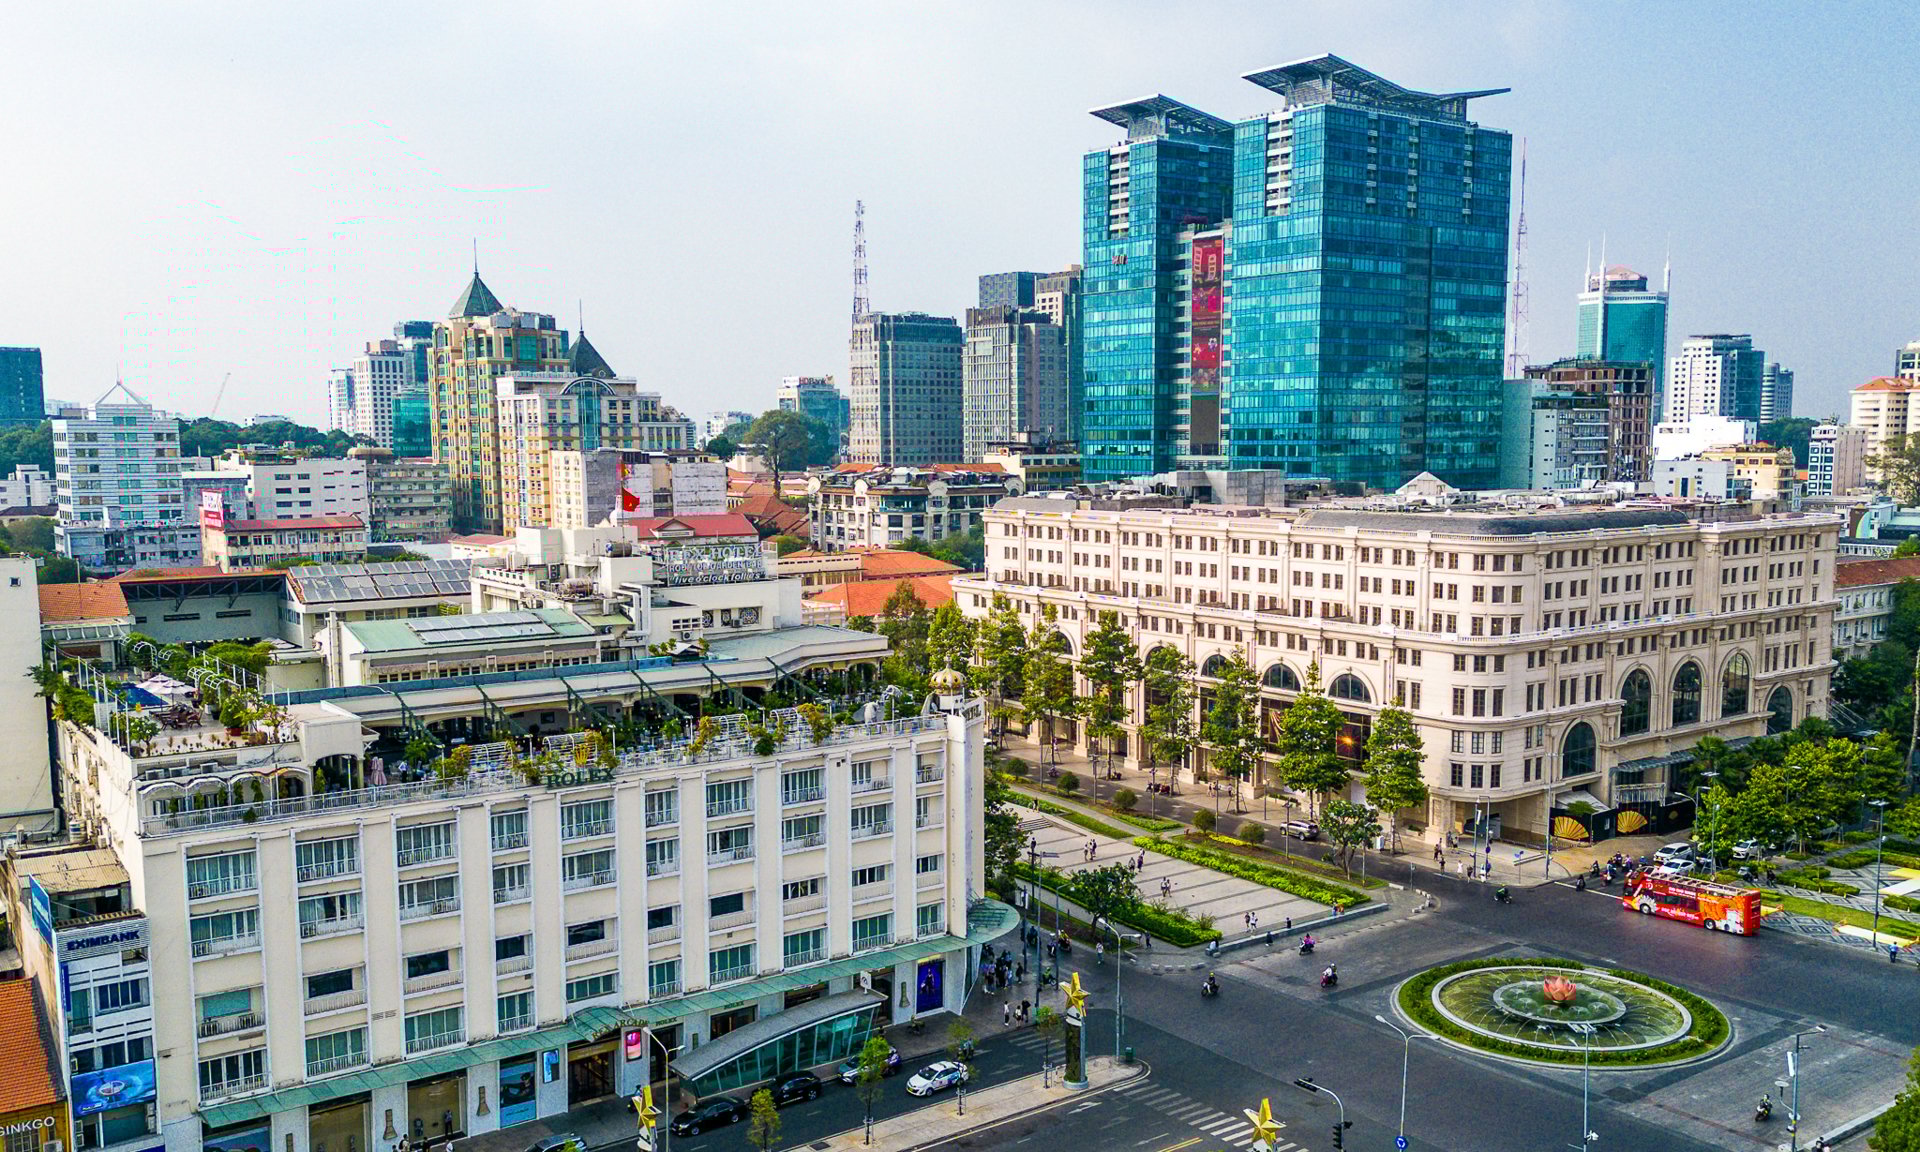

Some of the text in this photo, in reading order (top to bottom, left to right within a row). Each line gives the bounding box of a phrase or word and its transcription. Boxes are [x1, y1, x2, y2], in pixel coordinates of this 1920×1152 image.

[669, 545, 762, 560] REX HOTEL
[546, 767, 616, 788] ROLEX
[67, 931, 139, 950] EXIMBANK
